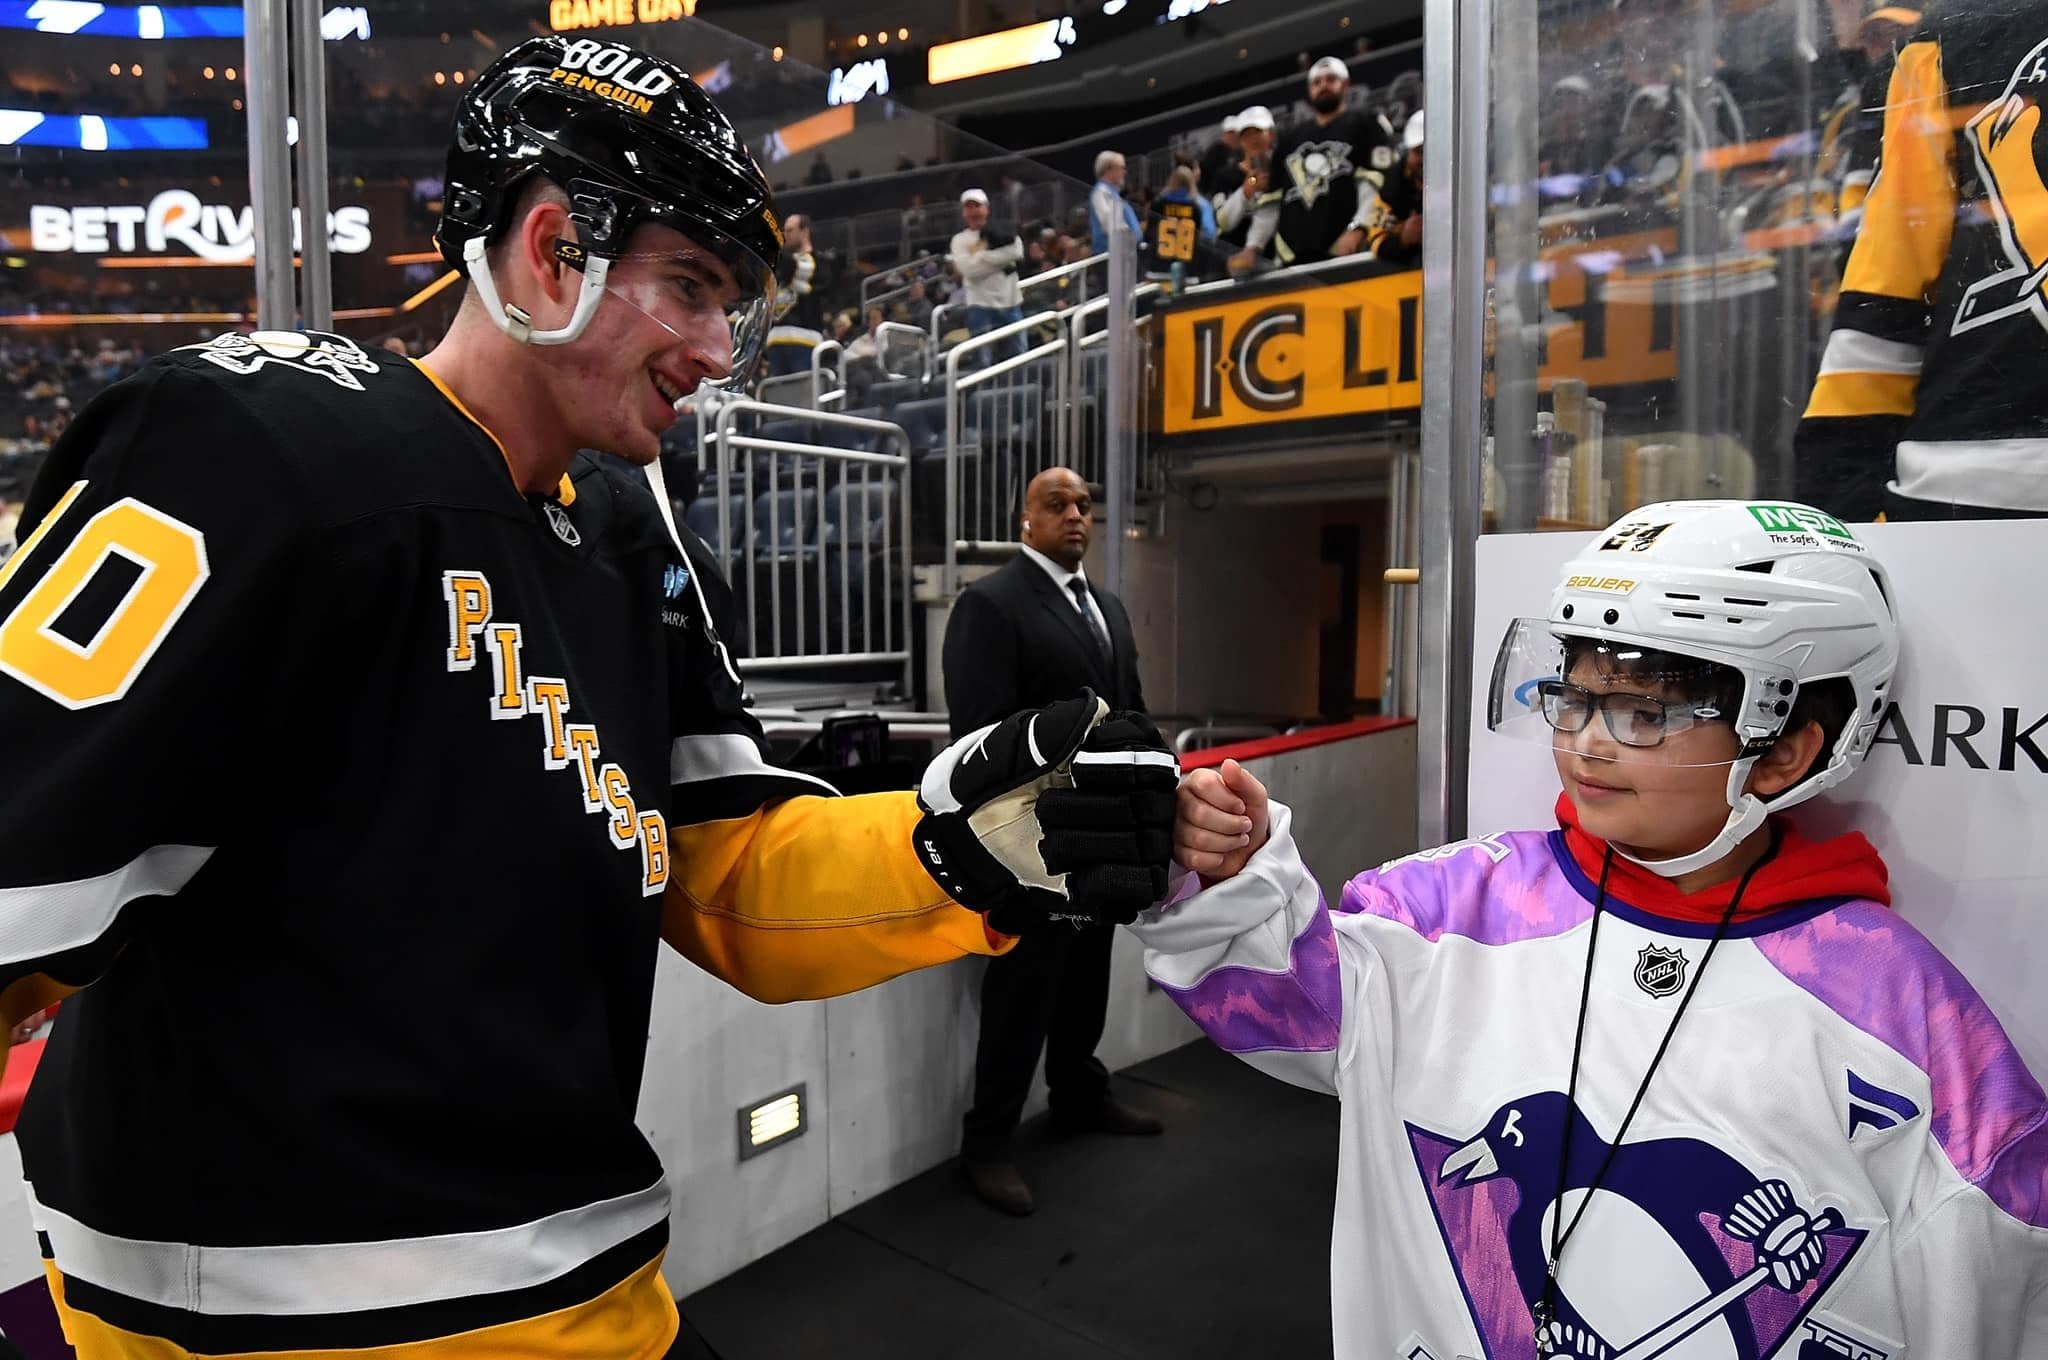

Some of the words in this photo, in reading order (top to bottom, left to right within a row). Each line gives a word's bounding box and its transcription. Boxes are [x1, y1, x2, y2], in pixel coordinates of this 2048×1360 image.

[550, 0, 635, 31] GAME
[638, 0, 698, 23] DAY
[560, 38, 674, 96] BOLD
[550, 68, 655, 113] PENGUIN
[30, 190, 372, 263] BETRIVS
[1157, 218, 1195, 261] 58
[1191, 302, 1305, 420] IC
[1755, 507, 1851, 536] MSA
[1769, 534, 1789, 544] The
[0, 479, 211, 711] 0
[1566, 576, 1635, 592] BAUER
[443, 569, 669, 897] PITTSB
[1647, 963, 1674, 982] NHL
